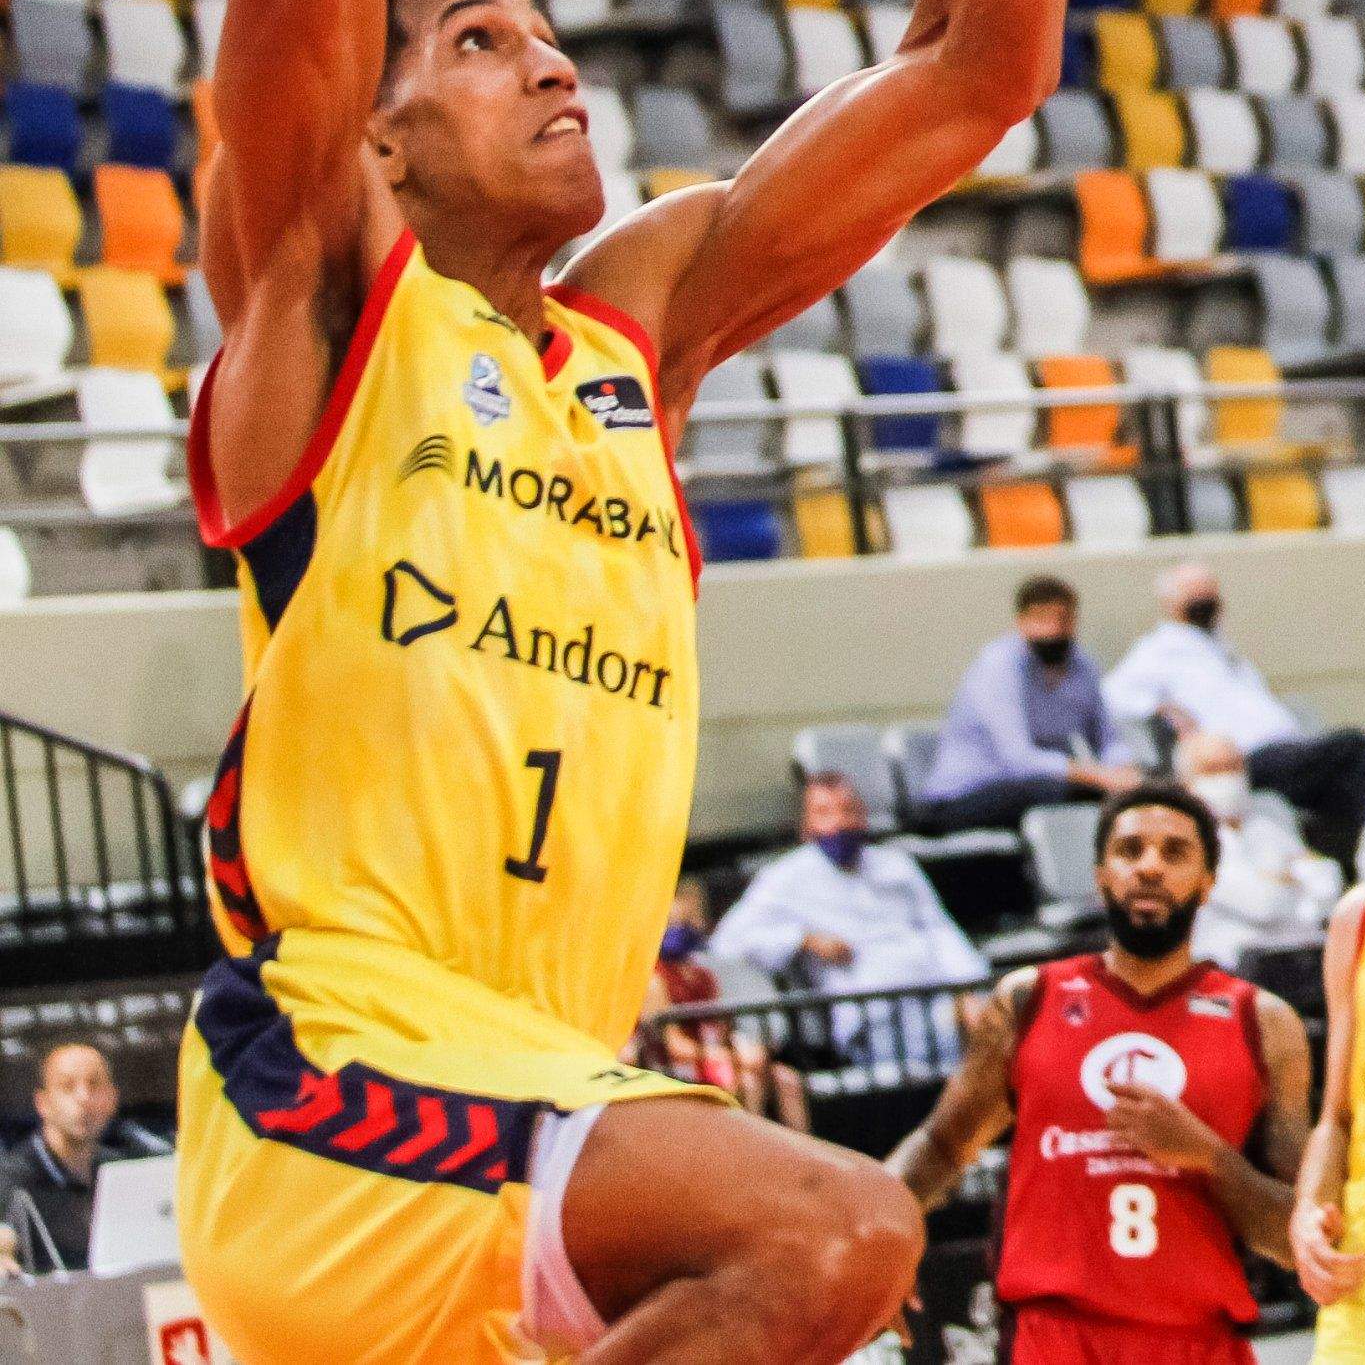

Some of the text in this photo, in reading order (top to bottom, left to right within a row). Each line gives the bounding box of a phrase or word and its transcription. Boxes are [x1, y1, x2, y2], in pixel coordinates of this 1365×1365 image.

[468, 596, 675, 711] Andorr
[504, 749, 563, 884] 1
[1109, 1184, 1159, 1258] 8
